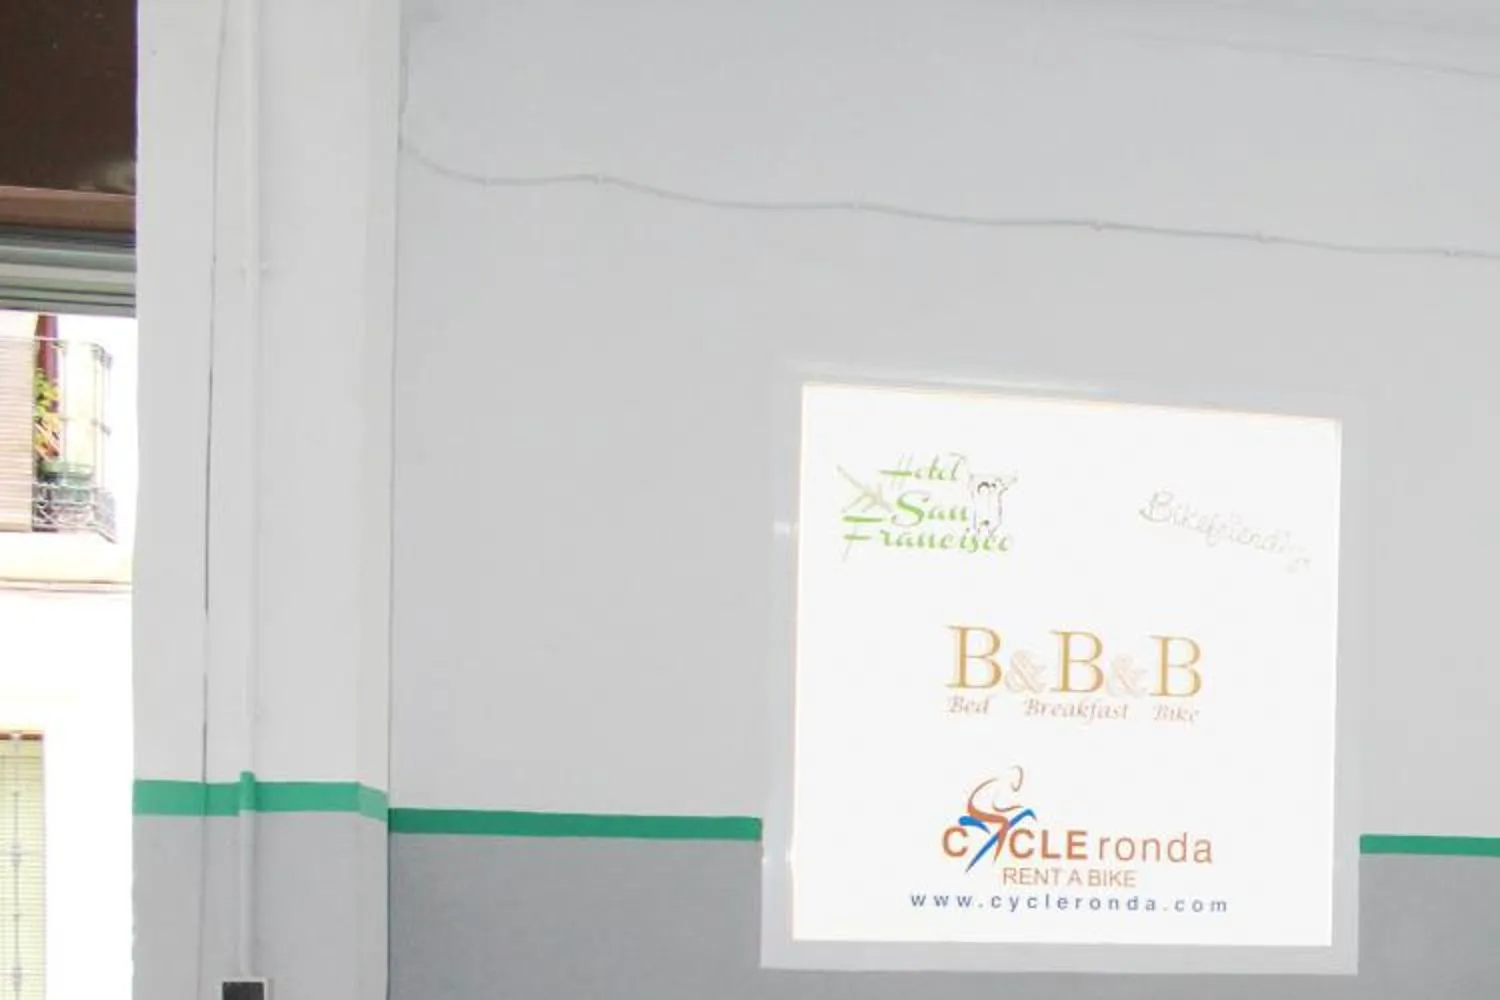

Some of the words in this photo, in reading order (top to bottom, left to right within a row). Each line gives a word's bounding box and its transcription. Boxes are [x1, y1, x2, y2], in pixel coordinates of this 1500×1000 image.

[890, 489, 968, 527] San
[948, 696, 990, 715] Bed
[1023, 698, 1129, 726] Breakfast
[1152, 702, 1202, 722] Bike
[1003, 867, 1060, 887] RENT
[1066, 869, 1083, 887] A
[1087, 870, 1138, 889] BIKE
[910, 892, 1229, 913] www.cycleronda.com
